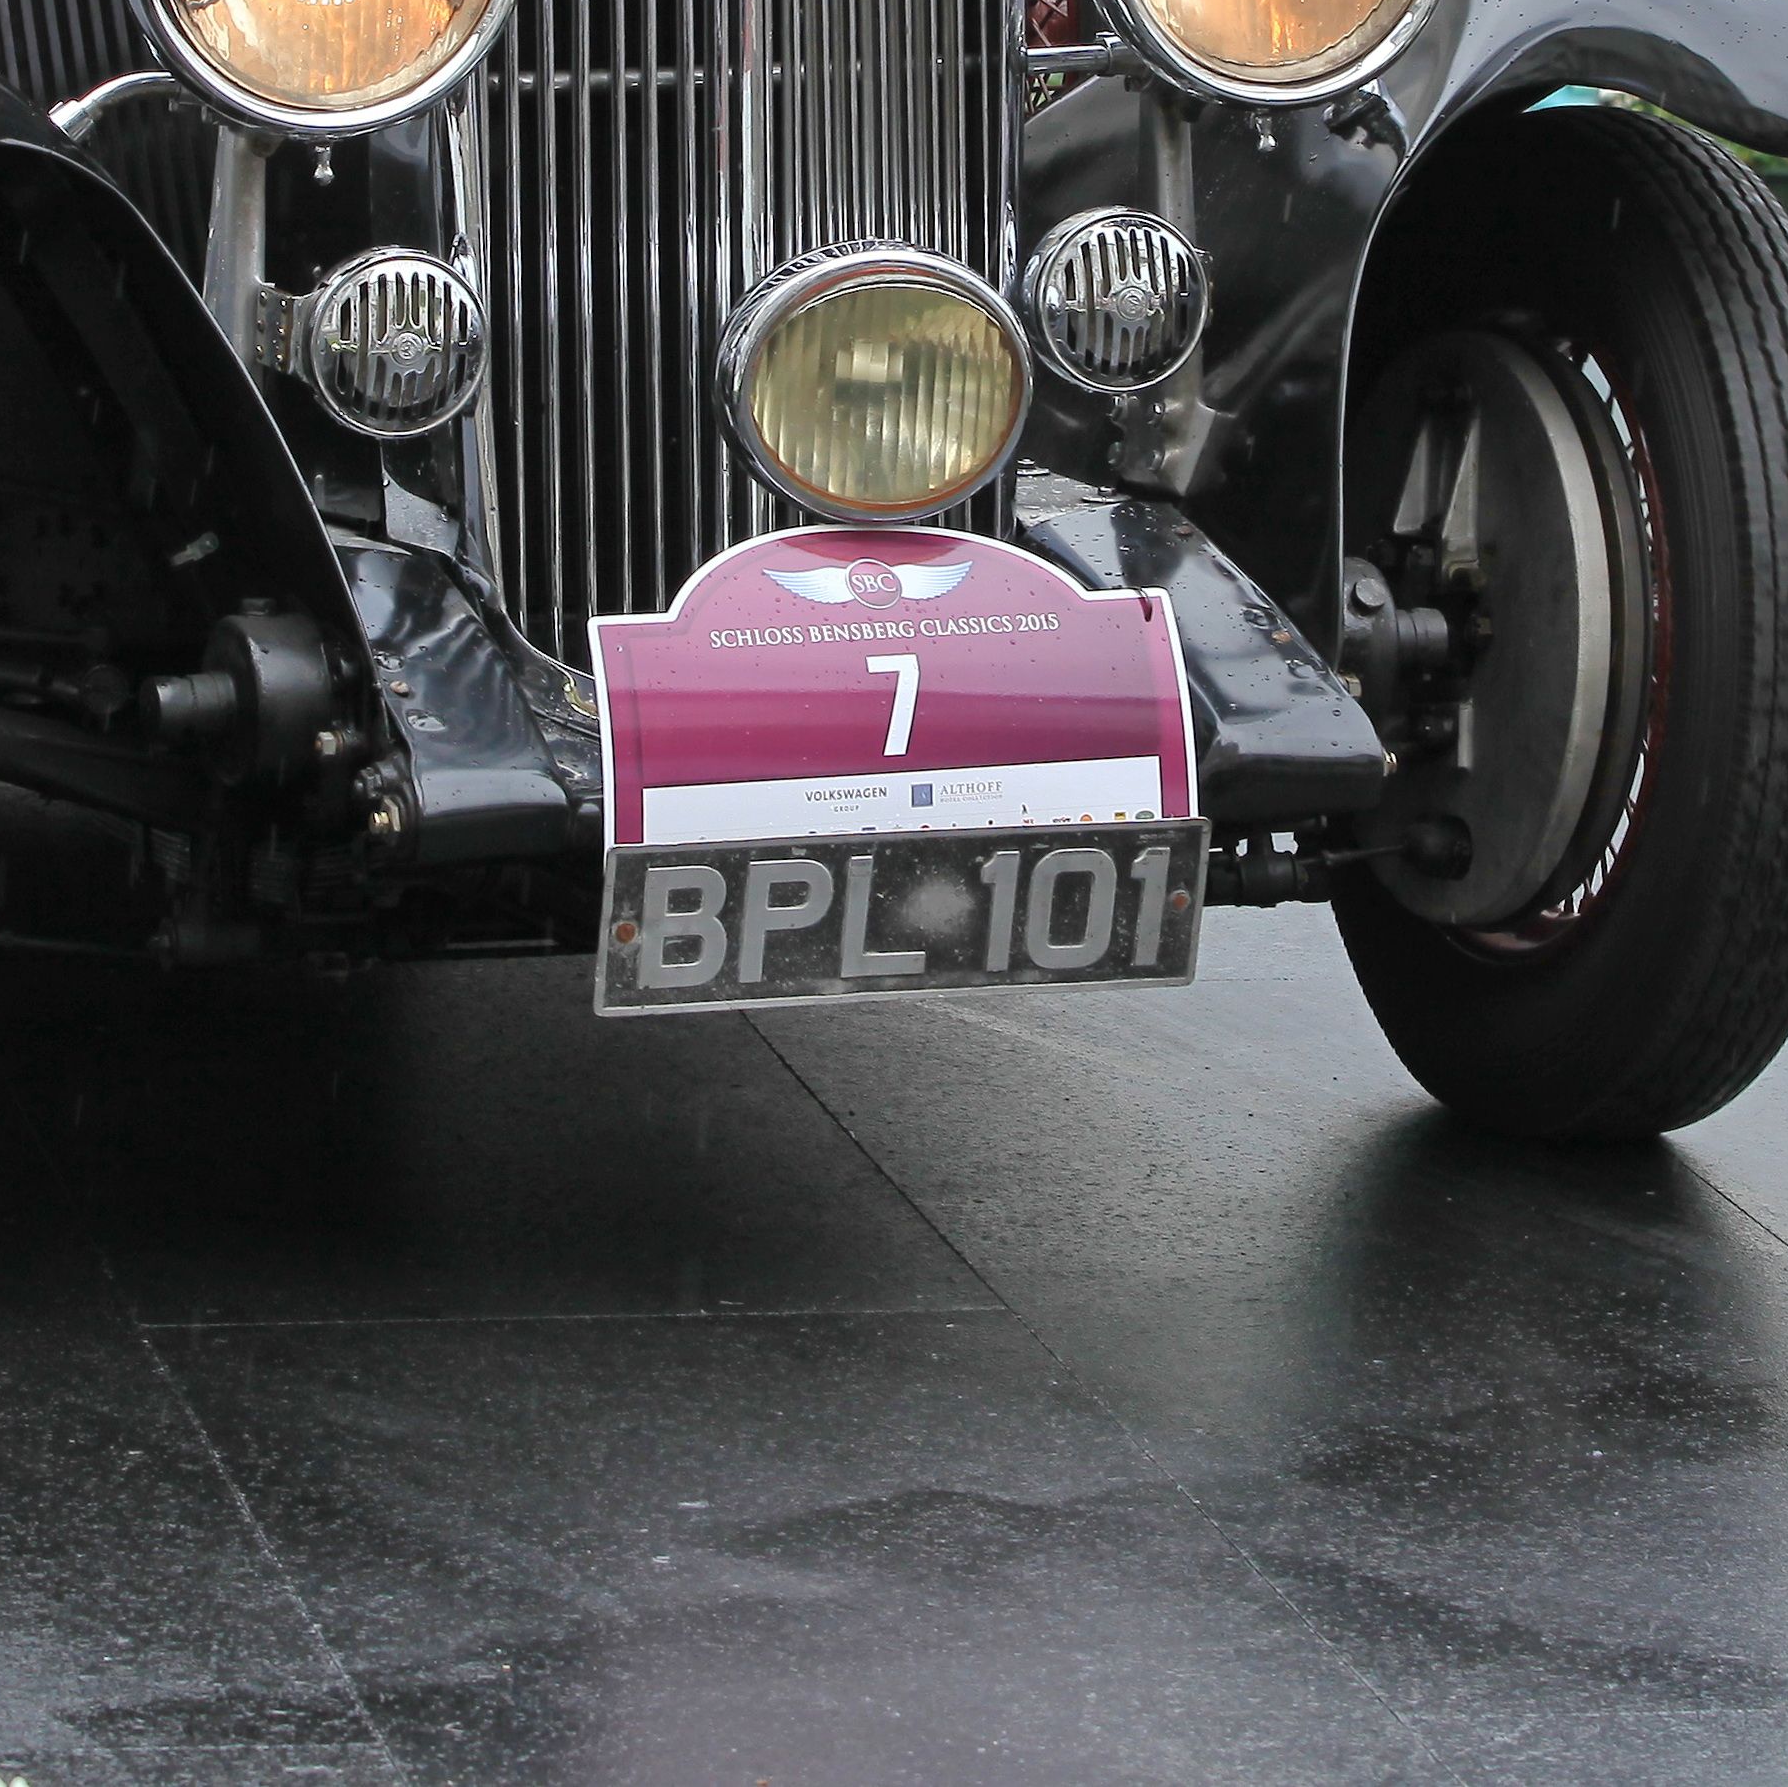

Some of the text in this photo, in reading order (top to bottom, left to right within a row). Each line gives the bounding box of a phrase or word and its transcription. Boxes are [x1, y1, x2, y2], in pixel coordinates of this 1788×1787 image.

[851, 573, 897, 594] SBC
[709, 612, 1060, 649] SCHLOSS BENSBERG CLASSICS 2015
[865, 653, 921, 757] 7
[804, 786, 888, 802] VOLKSWAGEN
[939, 781, 1004, 796] ALTHOFF
[833, 805, 860, 813] GROUP
[635, 846, 1172, 991] BPL 101
